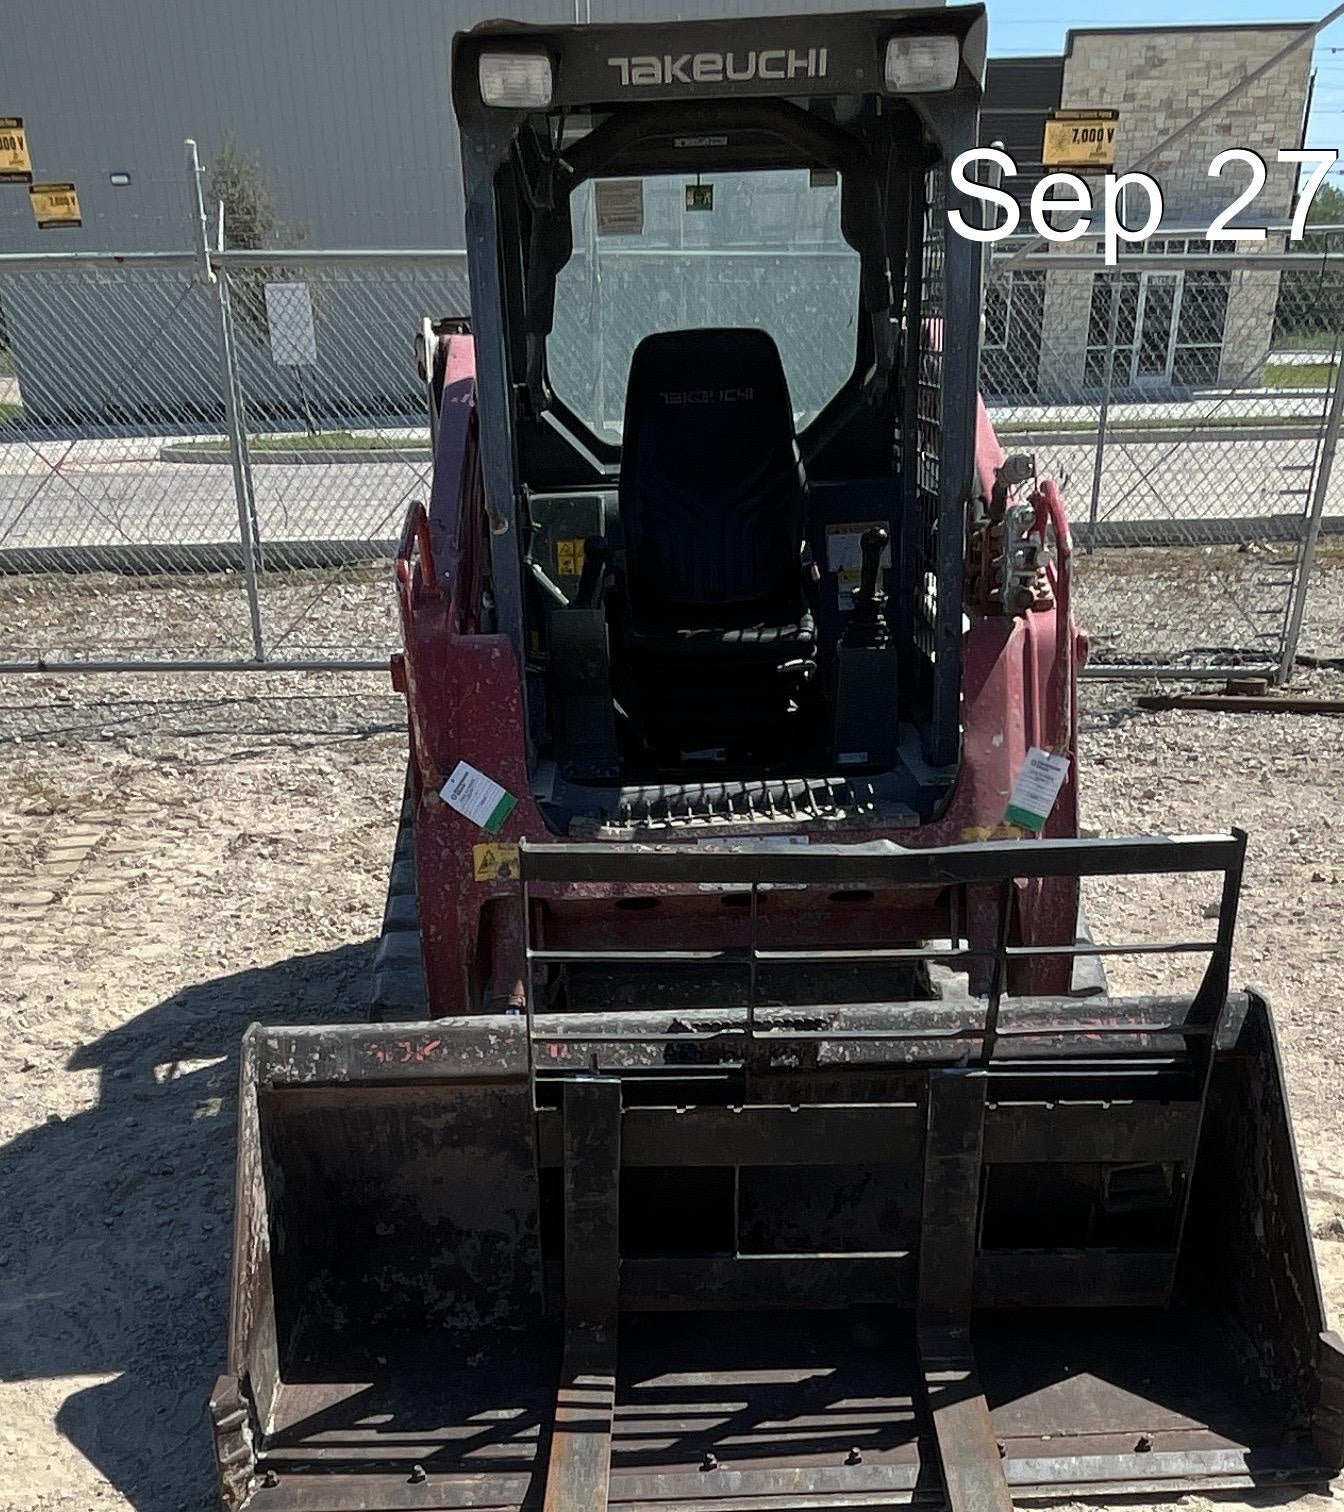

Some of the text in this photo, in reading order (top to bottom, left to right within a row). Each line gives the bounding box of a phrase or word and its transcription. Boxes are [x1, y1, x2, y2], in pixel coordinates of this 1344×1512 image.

[607, 48, 828, 86] TAKEUCHI
[16, 135, 24, 151] V
[1071, 127, 1115, 144] 7,000 V
